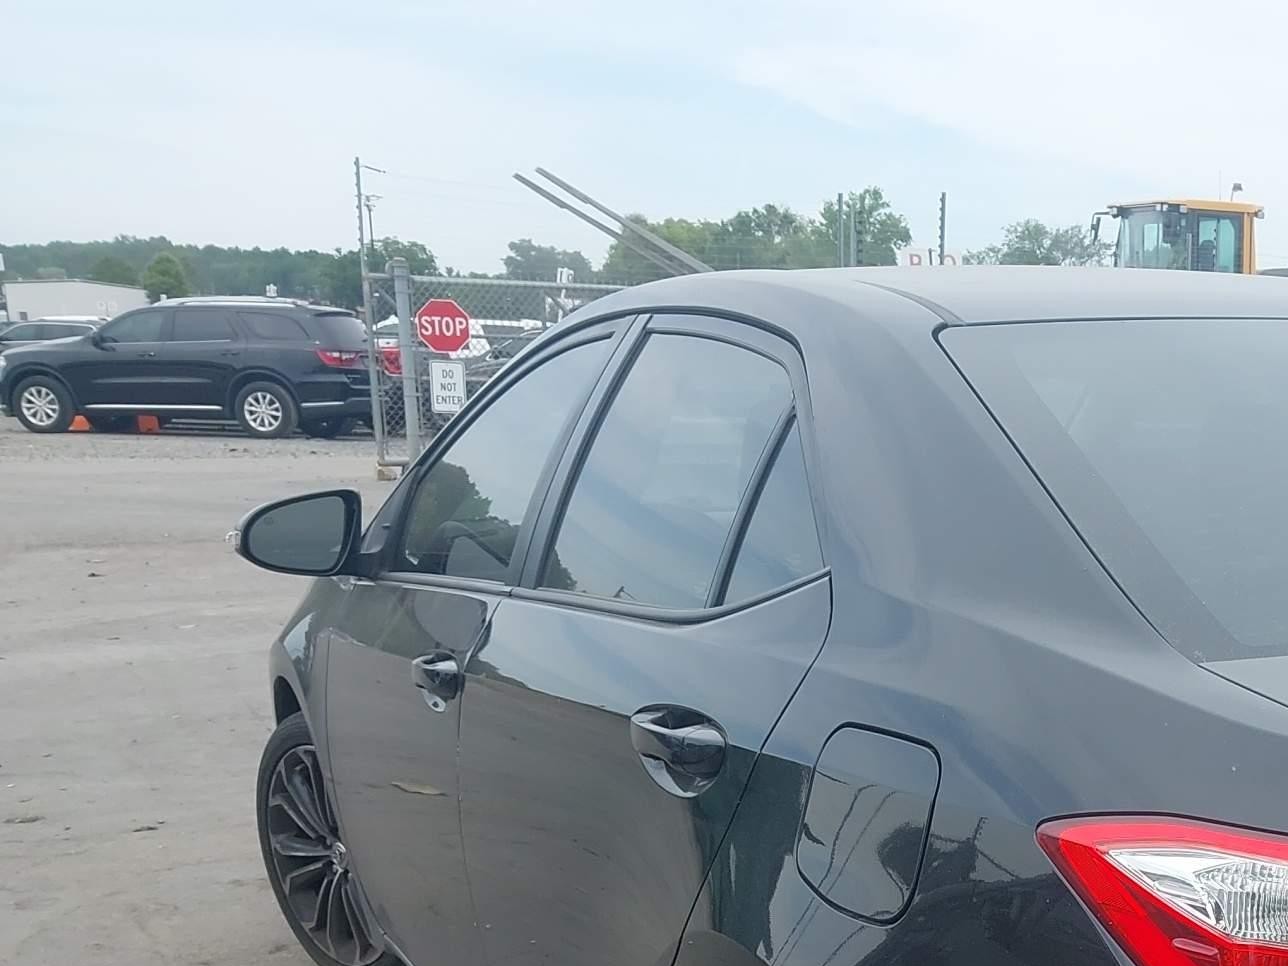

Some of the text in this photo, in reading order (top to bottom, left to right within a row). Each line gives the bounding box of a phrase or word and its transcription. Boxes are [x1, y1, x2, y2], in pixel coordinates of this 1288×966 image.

[421, 316, 467, 336] STOP
[442, 369, 454, 379] DO
[440, 382, 457, 392] NOT
[436, 395, 463, 405] ENTER
